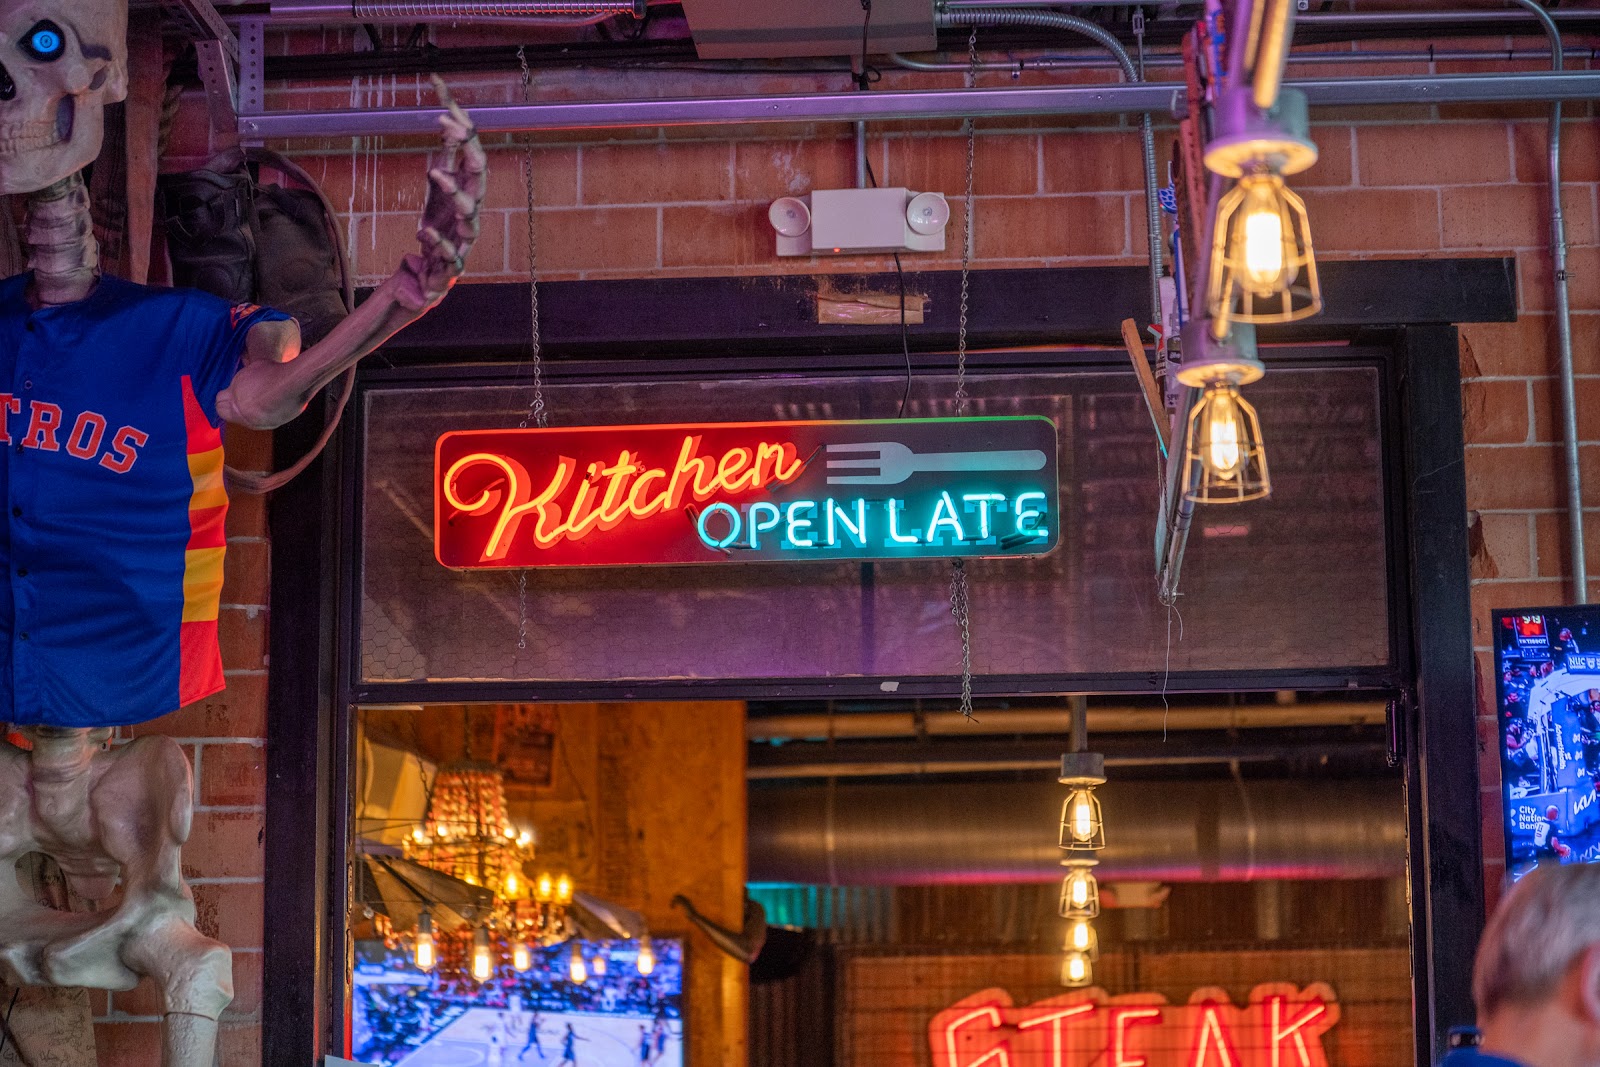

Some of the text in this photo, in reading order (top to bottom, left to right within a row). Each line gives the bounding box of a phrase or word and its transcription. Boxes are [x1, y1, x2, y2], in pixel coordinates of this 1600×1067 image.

[444, 435, 803, 561] Kitchen
[697, 491, 1049, 551] OPEN LATE
[1519, 805, 1536, 815] City
[936, 990, 1334, 1067] STEAK
